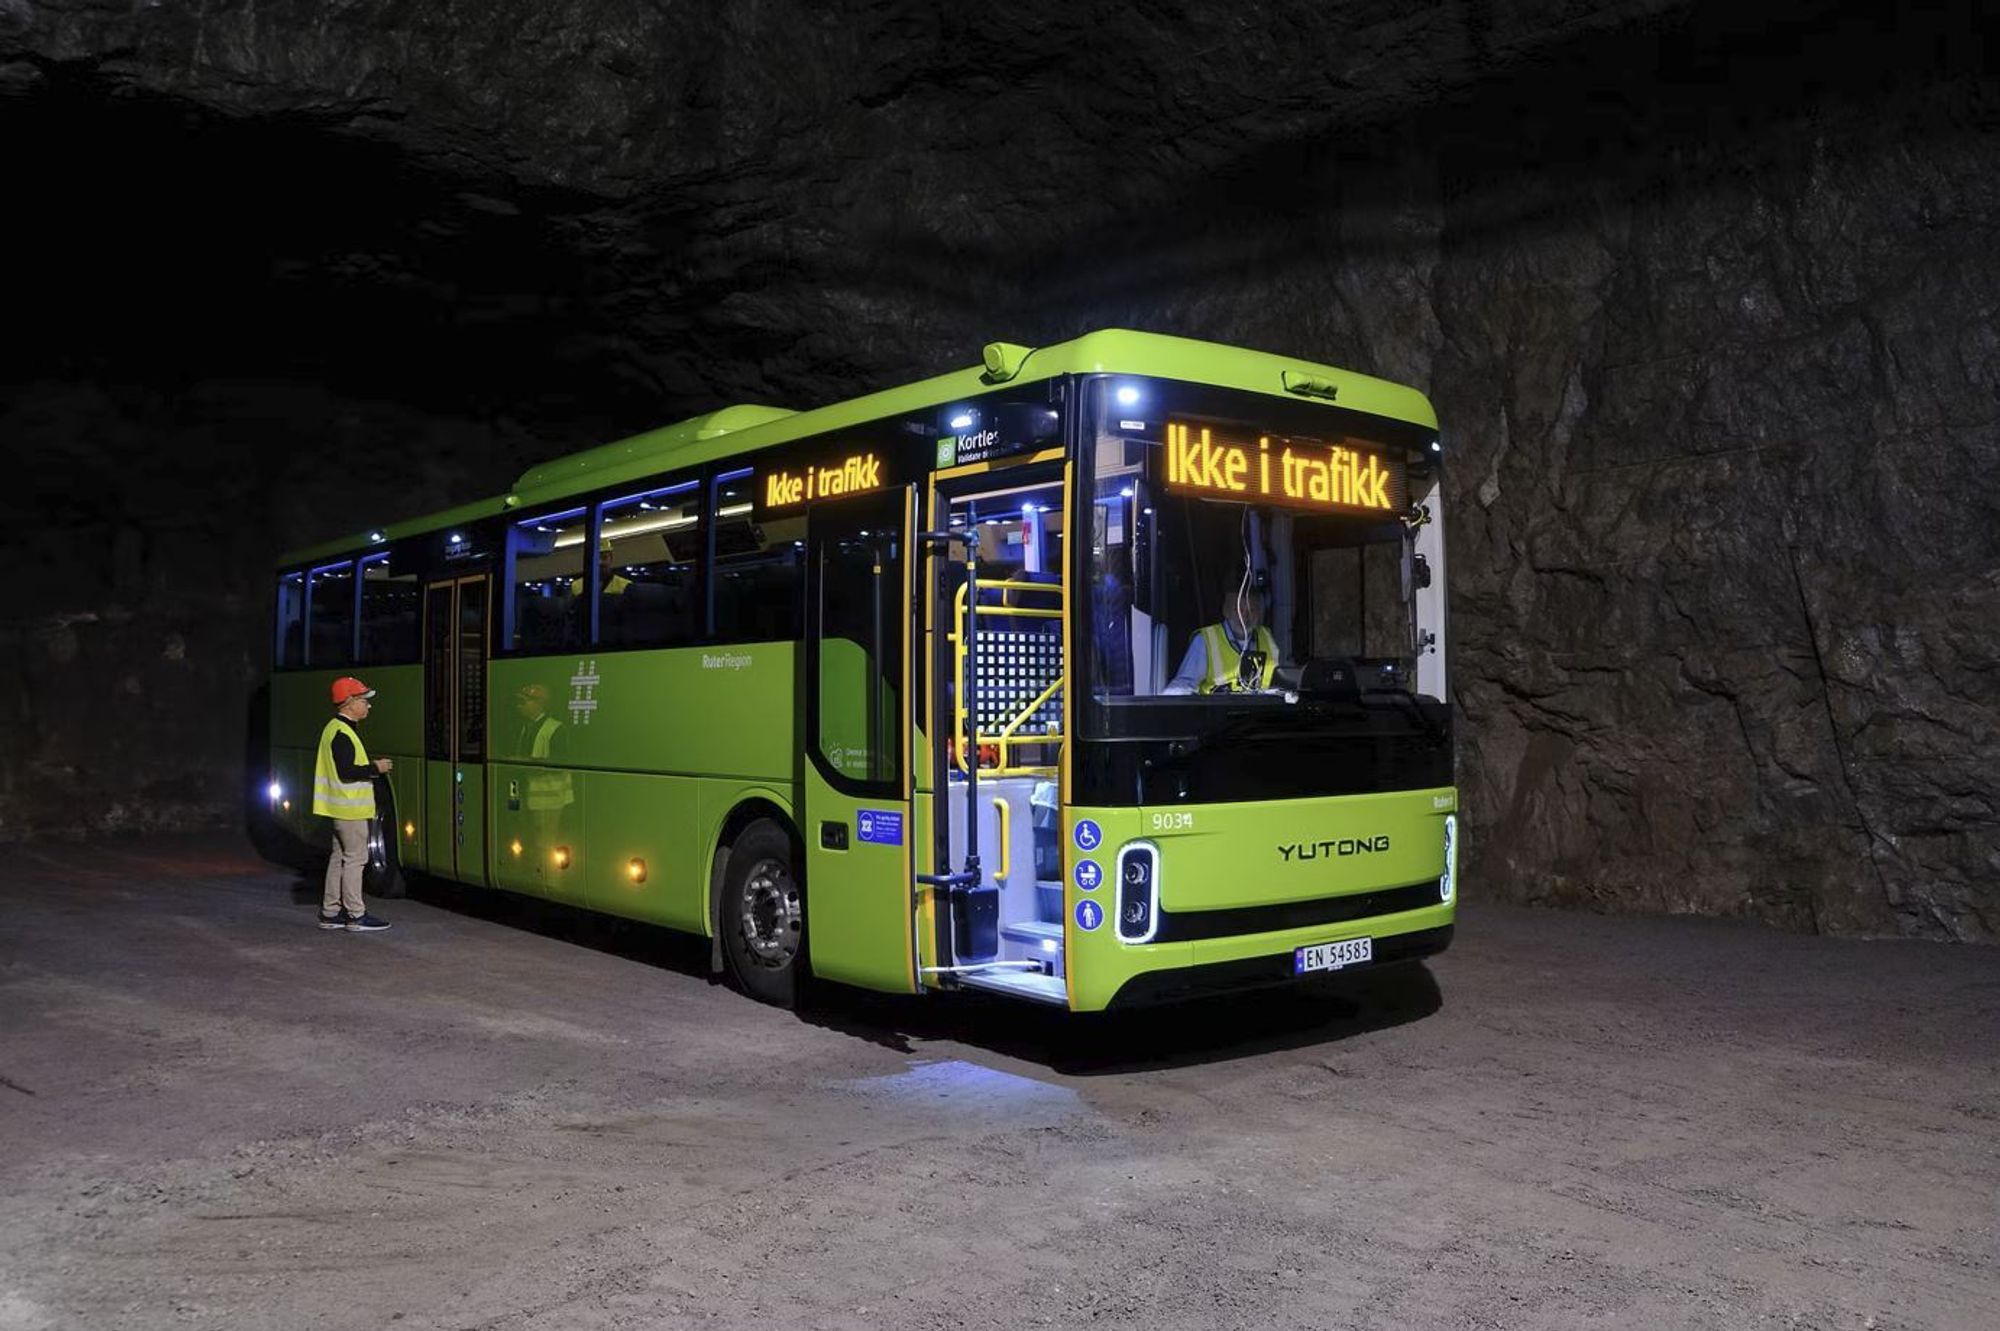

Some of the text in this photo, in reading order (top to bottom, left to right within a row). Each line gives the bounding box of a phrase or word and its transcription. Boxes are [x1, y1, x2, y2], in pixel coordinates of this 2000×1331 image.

[767, 453, 880, 507] Ikke i trafikk
[1167, 424, 1391, 509] Ikke i trafikk
[1152, 812, 1193, 830] 9034
[1278, 835, 1389, 861] YUTONG
[1306, 940, 1369, 968] EN 54585
